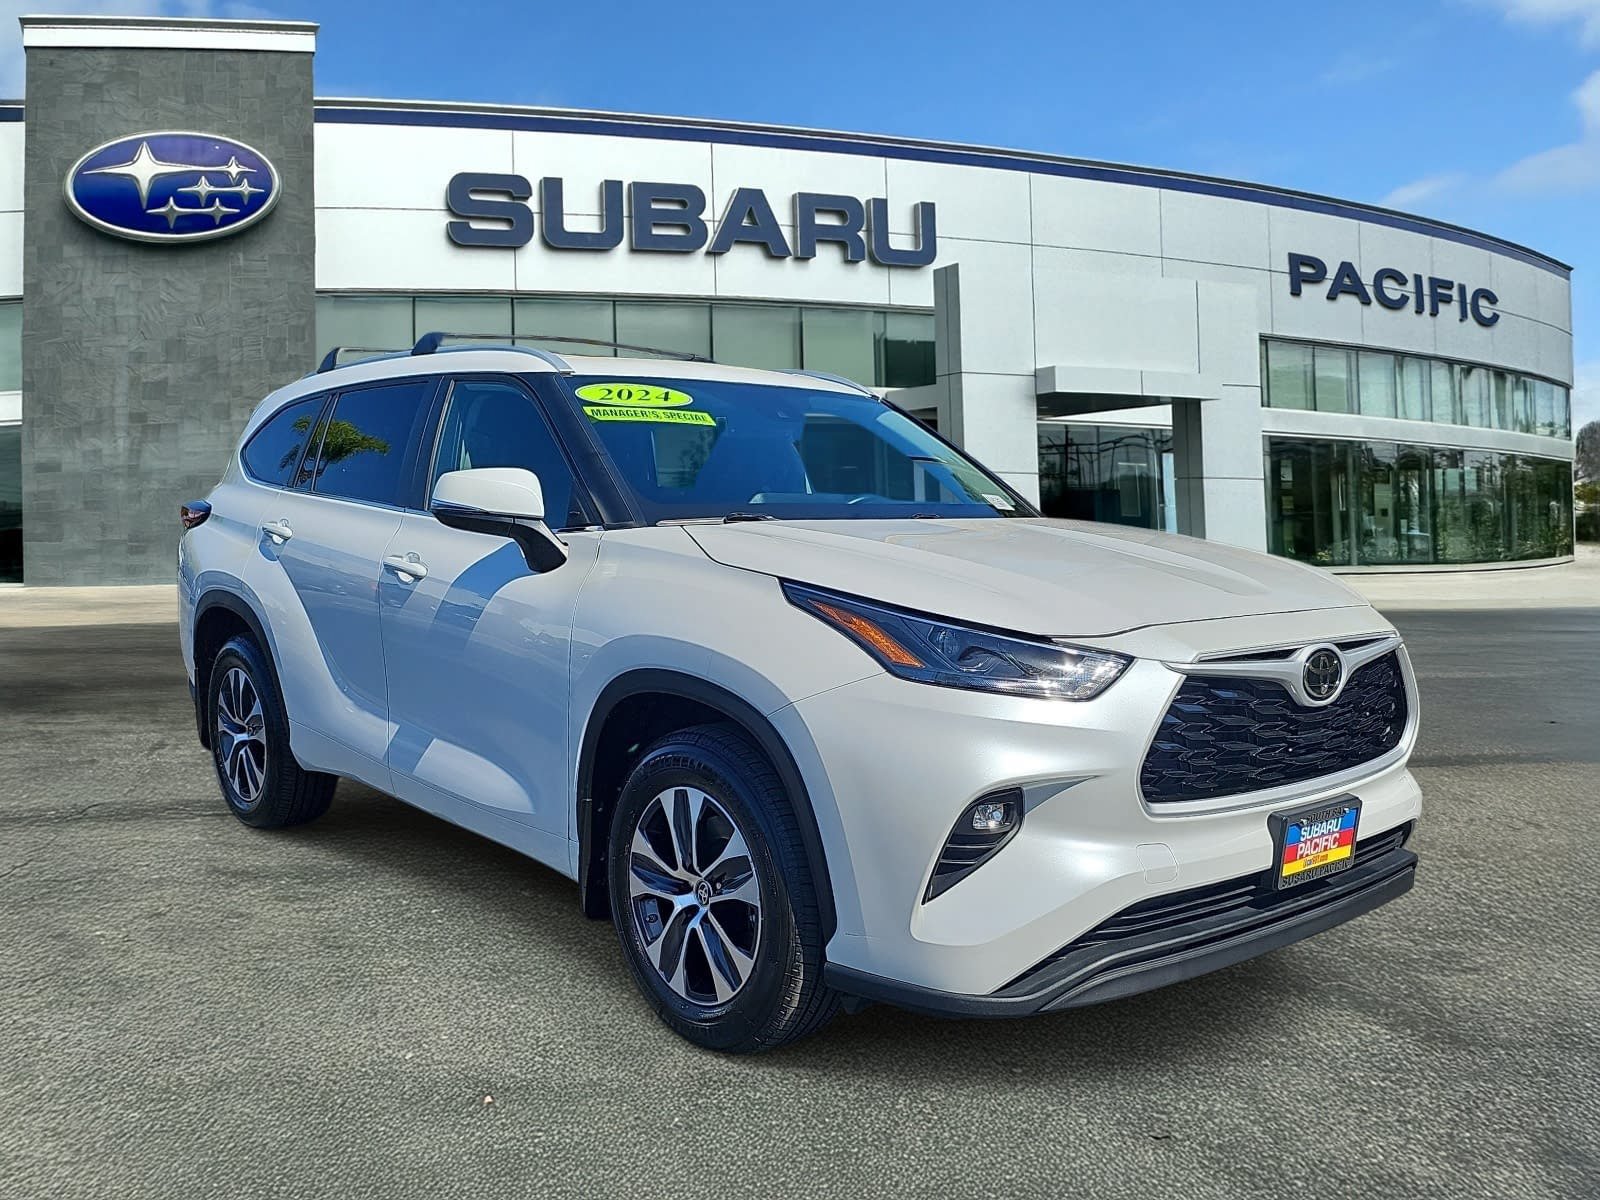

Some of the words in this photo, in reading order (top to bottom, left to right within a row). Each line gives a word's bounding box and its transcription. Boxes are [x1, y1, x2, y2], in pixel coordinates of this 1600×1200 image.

[446, 172, 937, 268] SUBARU
[1287, 252, 1500, 327] PACIFIC
[598, 388, 672, 402] 2024
[591, 408, 659, 419] MANAGER'S
[662, 411, 708, 422] SPECIAL
[1300, 817, 1342, 841] SUBARU
[1296, 833, 1340, 860] PACIFIC
[1281, 866, 1320, 887] SUBARU
